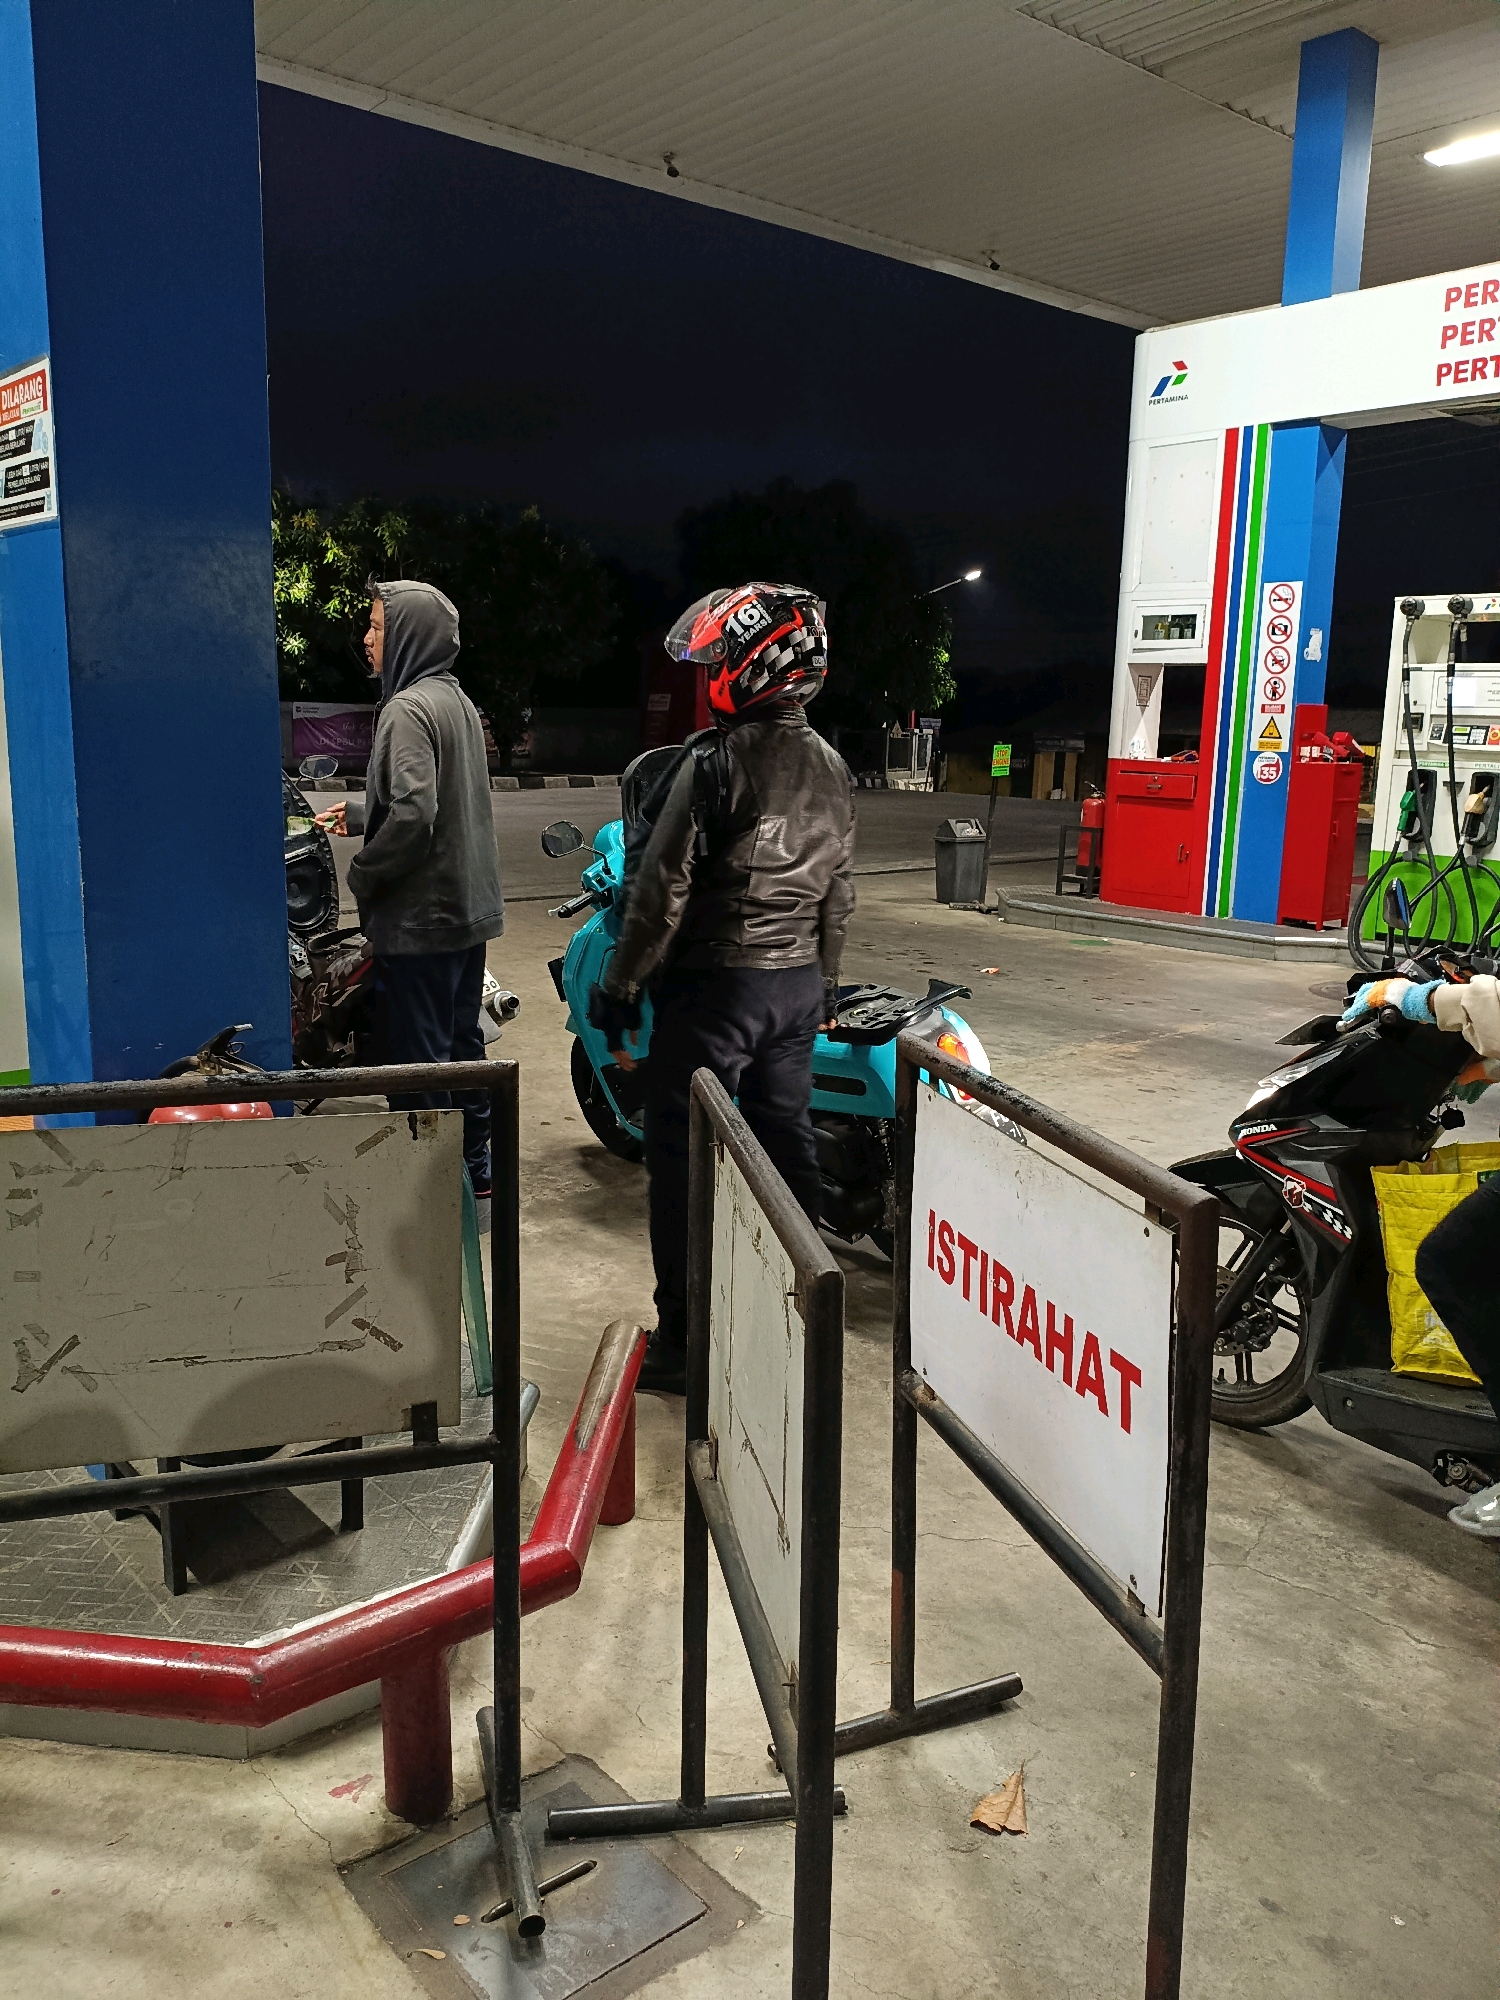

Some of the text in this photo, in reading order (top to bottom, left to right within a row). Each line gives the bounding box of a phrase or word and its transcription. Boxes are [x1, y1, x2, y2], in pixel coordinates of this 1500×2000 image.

[1, 375, 43, 411] DILARANG
[1148, 394, 1189, 406] PERTAMINA
[725, 603, 761, 637] 16
[738, 619, 768, 644] YEARS
[992, 758, 1010, 766] ENGINE
[1257, 767, 1277, 780] 135
[1240, 1124, 1277, 1137] HONDA
[928, 1208, 1142, 1435] ISTIRAHAT
